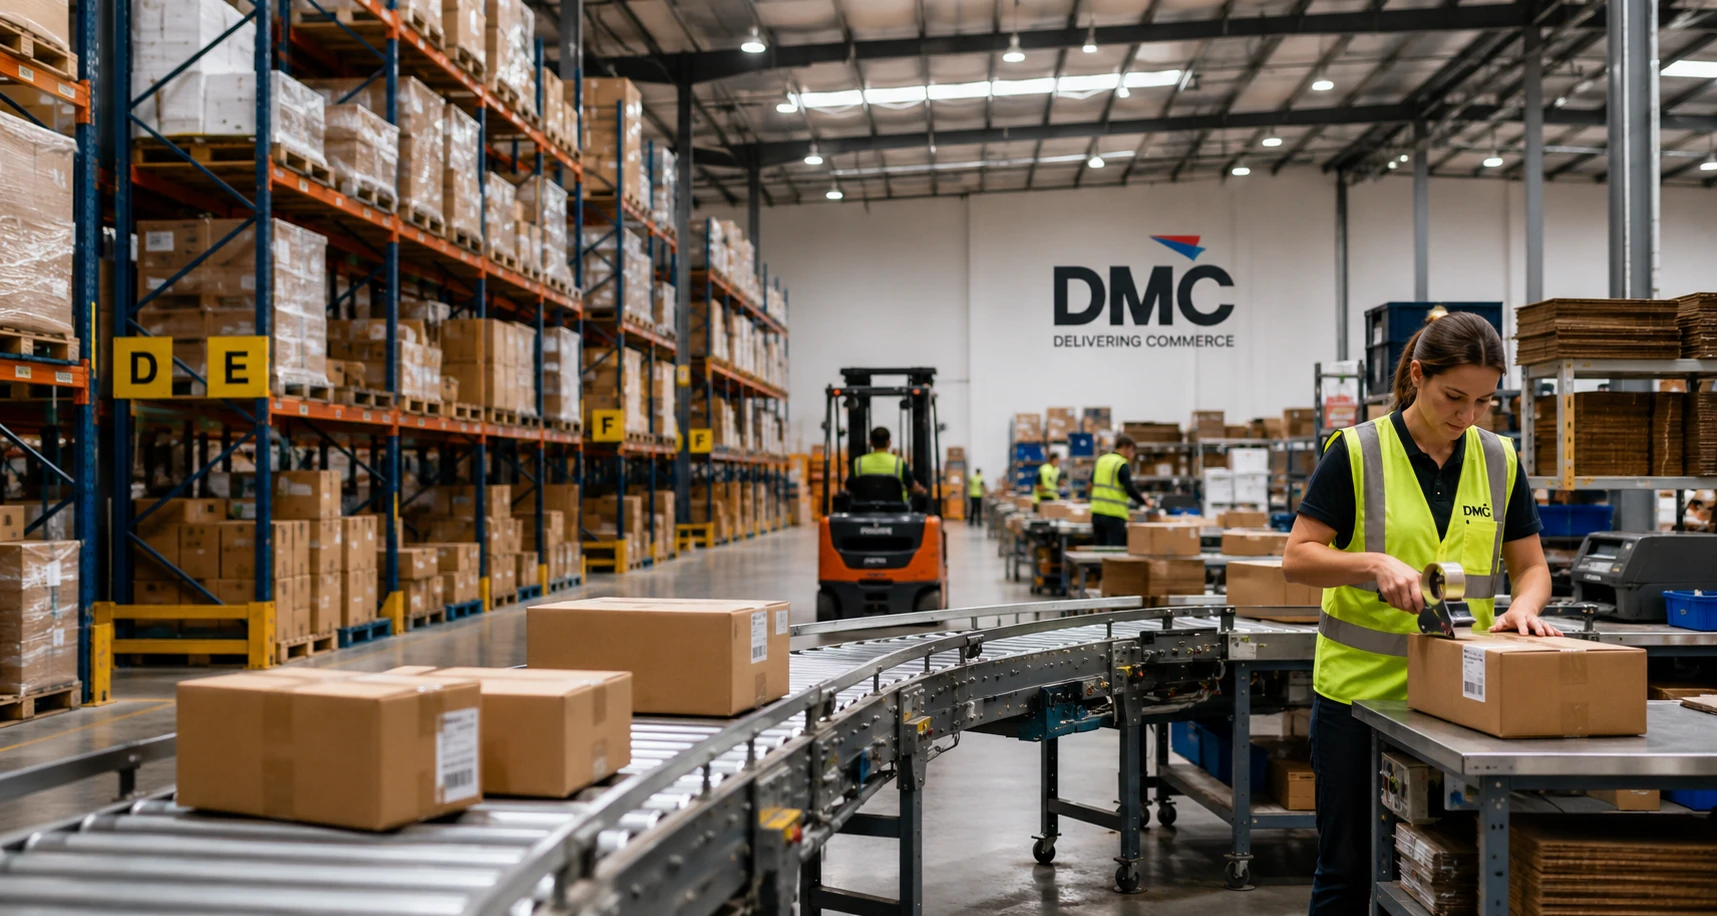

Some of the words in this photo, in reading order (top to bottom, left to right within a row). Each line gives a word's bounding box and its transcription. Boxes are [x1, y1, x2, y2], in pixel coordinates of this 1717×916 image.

[1053, 264, 1235, 327] DMC
[1053, 335, 1141, 348] DELIVERING
[1146, 335, 1235, 348] COMMERCE
[130, 351, 158, 385] D
[225, 351, 249, 385] E
[602, 416, 614, 435] F
[695, 433, 705, 448] F
